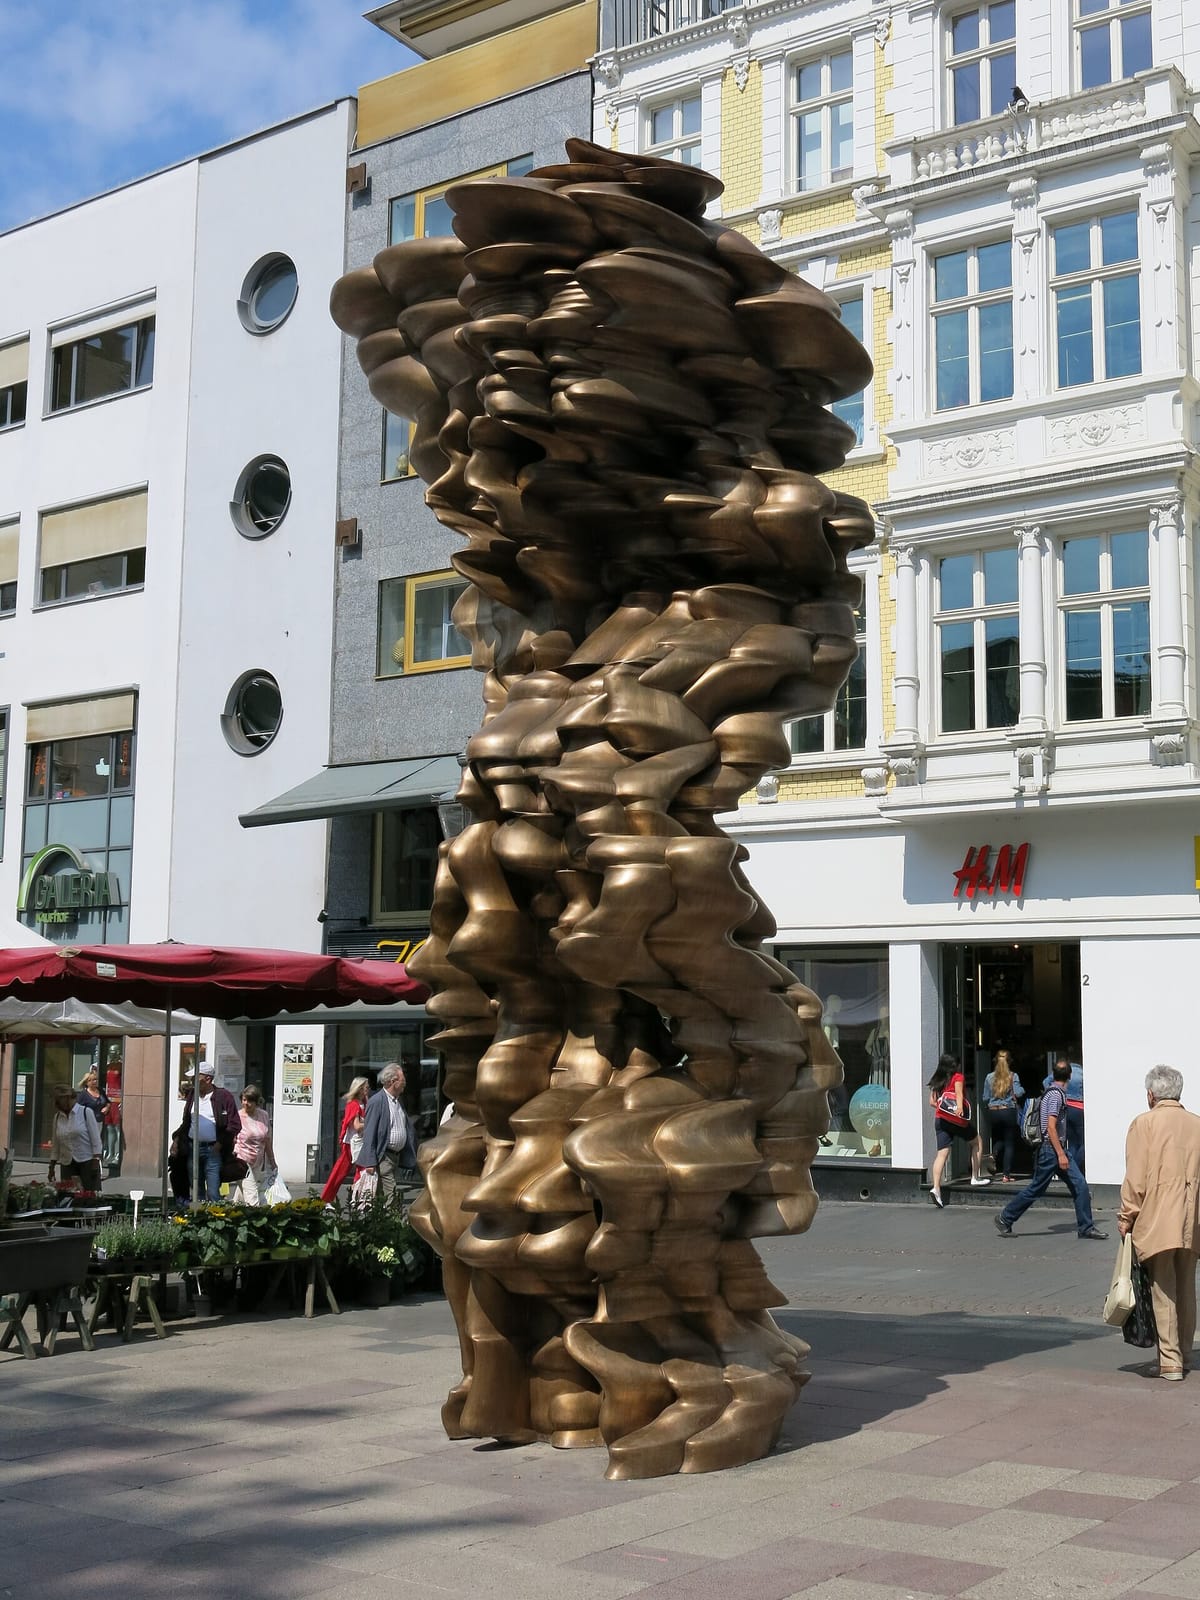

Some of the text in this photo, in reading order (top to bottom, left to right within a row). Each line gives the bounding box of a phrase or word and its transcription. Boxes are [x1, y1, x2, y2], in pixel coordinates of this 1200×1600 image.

[953, 843, 1030, 899] H&M
[35, 872, 117, 910] GALERIA
[1082, 974, 1090, 986] 2
[860, 1101, 889, 1110] KLEIDER
